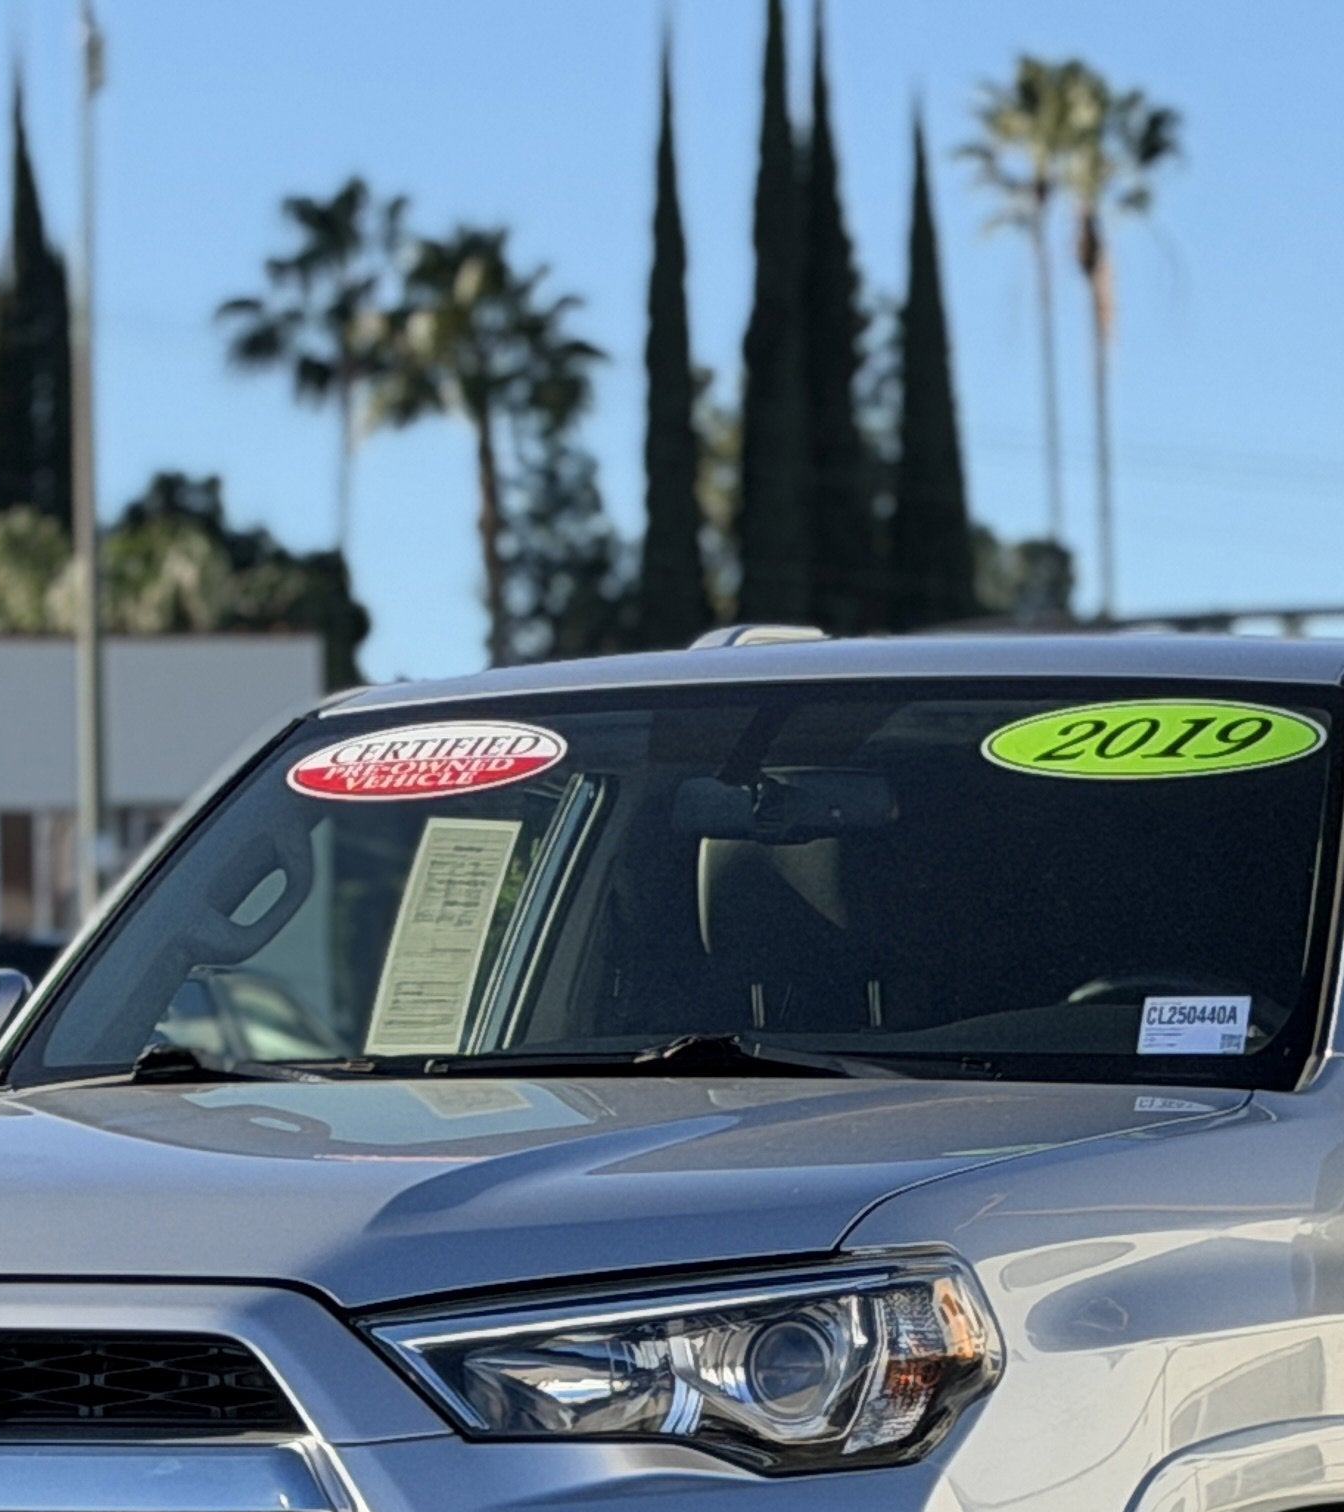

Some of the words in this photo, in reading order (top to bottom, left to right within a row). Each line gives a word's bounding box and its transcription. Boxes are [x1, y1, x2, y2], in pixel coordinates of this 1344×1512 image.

[329, 735, 541, 766] CERTIFIED
[1032, 716, 1273, 763] 2019
[322, 757, 515, 781] PRE-OWNED
[344, 771, 479, 792] VEHICLE
[1145, 1005, 1238, 1026] CL250440A
